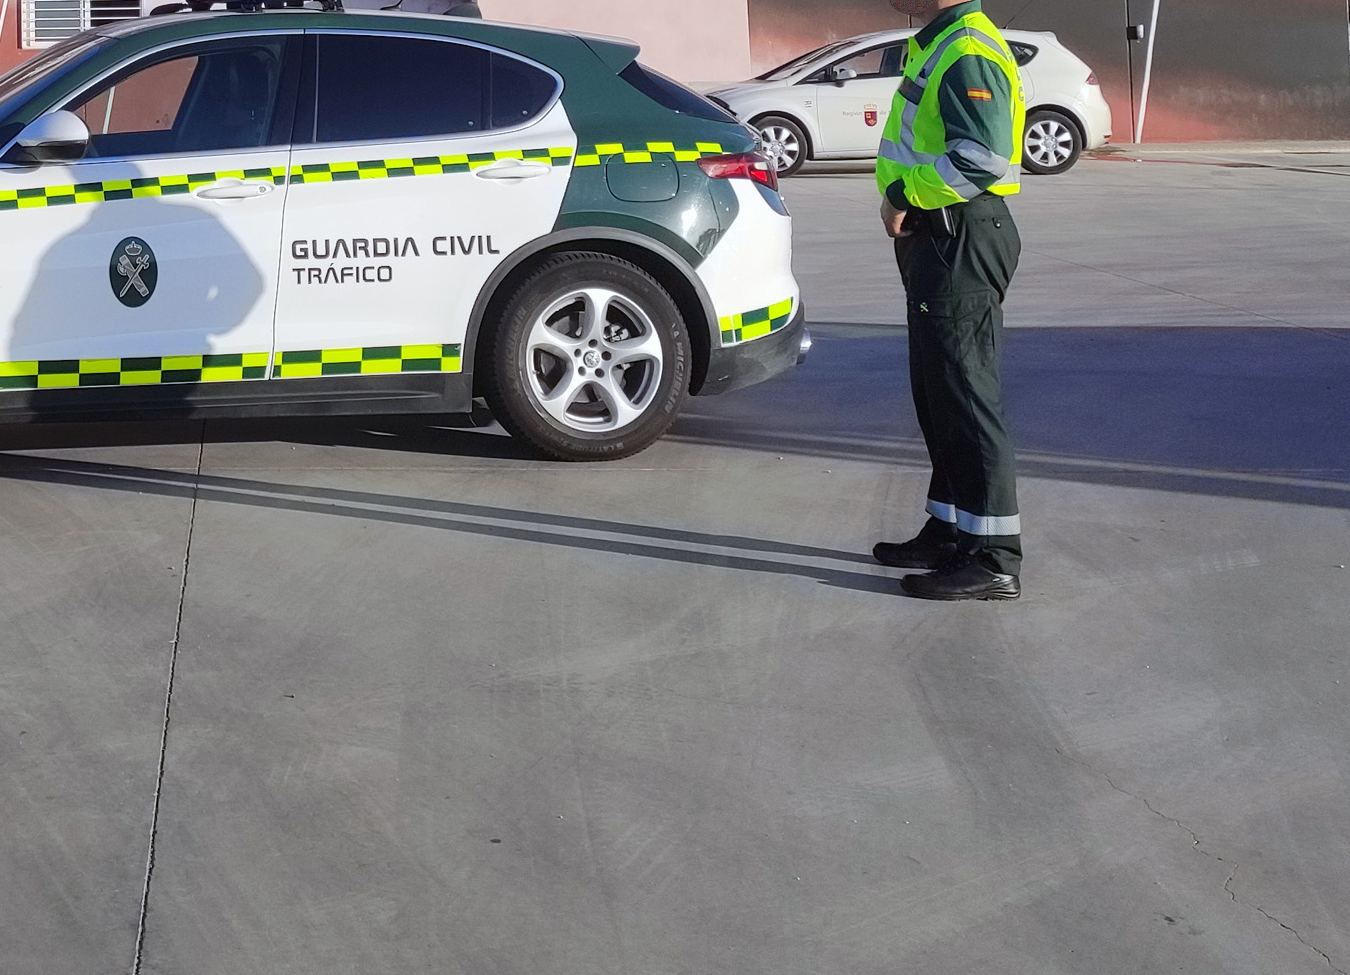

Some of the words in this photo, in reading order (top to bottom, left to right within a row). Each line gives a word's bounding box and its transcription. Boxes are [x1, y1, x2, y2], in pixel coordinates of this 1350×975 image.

[291, 237, 420, 259] GUARDIA
[432, 235, 500, 256] CIVIL
[292, 263, 392, 284] TRÁFICO
[664, 342, 684, 413] MICHELIN
